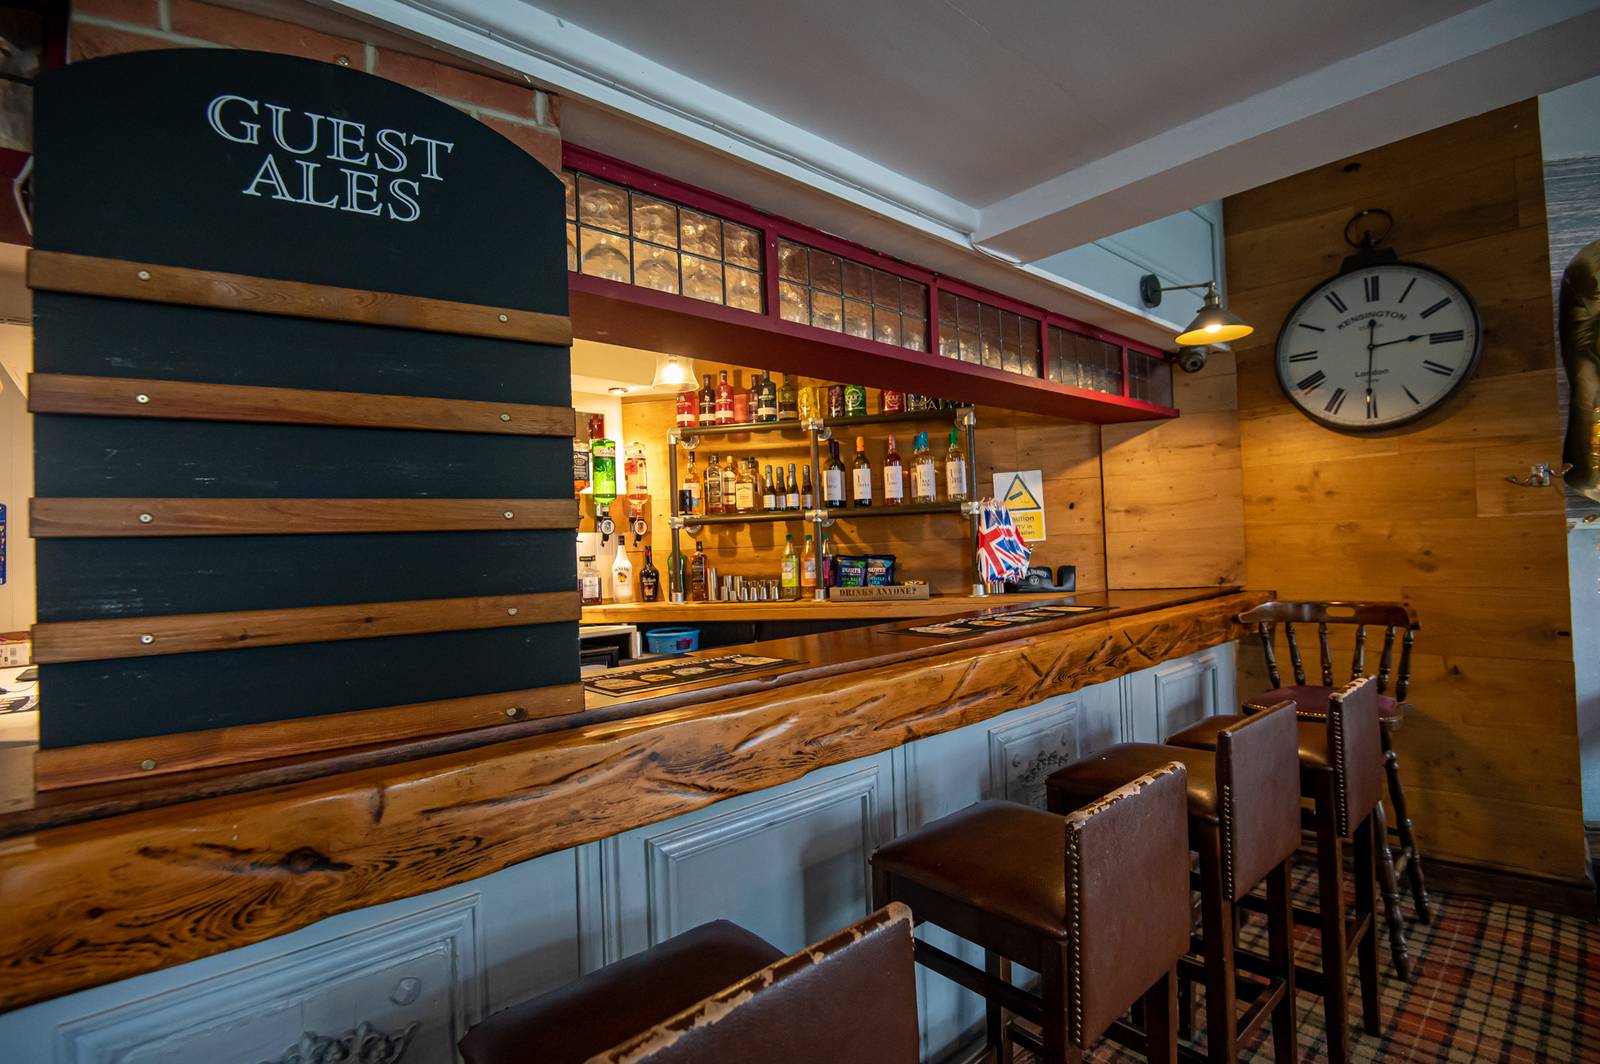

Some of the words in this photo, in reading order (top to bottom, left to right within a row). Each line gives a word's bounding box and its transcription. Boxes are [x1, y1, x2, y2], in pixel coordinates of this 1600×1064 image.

[207, 94, 455, 181] GUEST
[242, 153, 421, 222] ALES
[1336, 310, 1408, 330] KENSINGTON
[840, 589, 874, 597] DRINKS
[877, 587, 917, 596] ANYONE?
